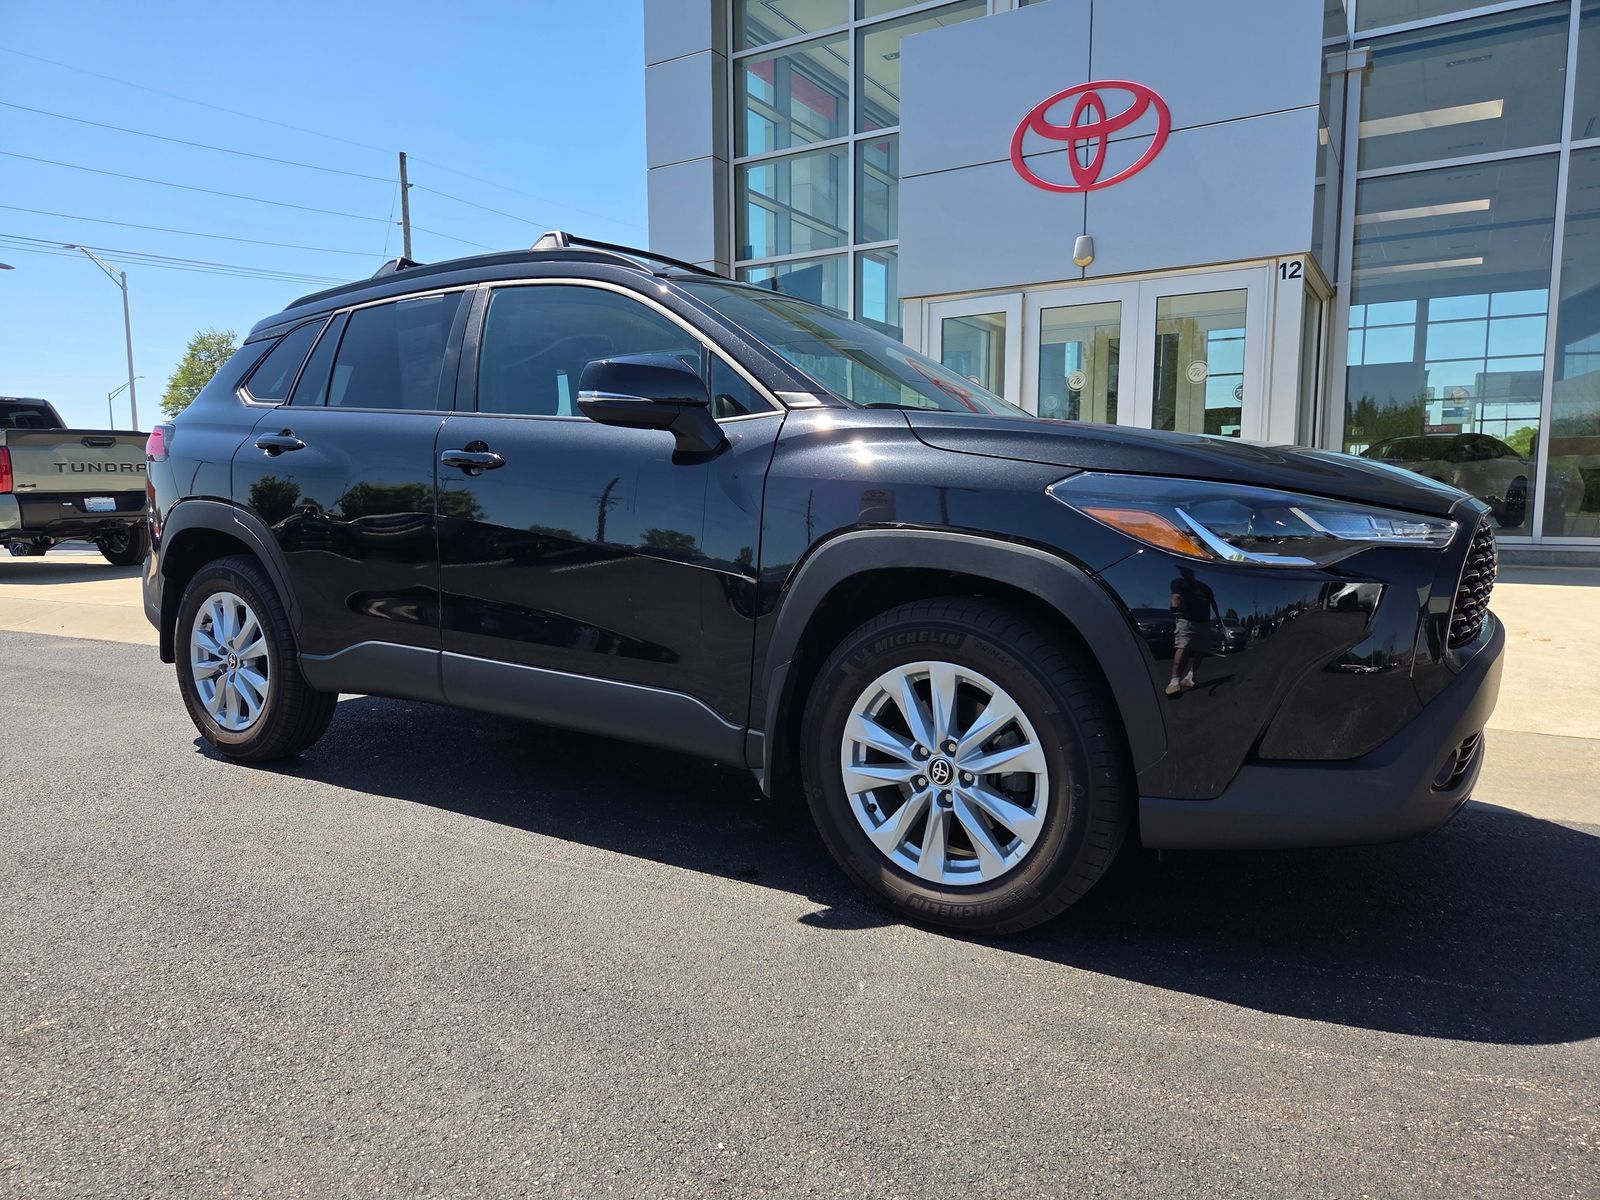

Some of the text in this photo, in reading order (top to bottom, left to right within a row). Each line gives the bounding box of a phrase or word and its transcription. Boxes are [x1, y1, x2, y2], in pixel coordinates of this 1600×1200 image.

[1280, 261, 1302, 280] 12
[54, 463, 146, 473] TUNDRA
[874, 631, 961, 654] MICHELIN
[907, 897, 999, 920] MICHELIN
